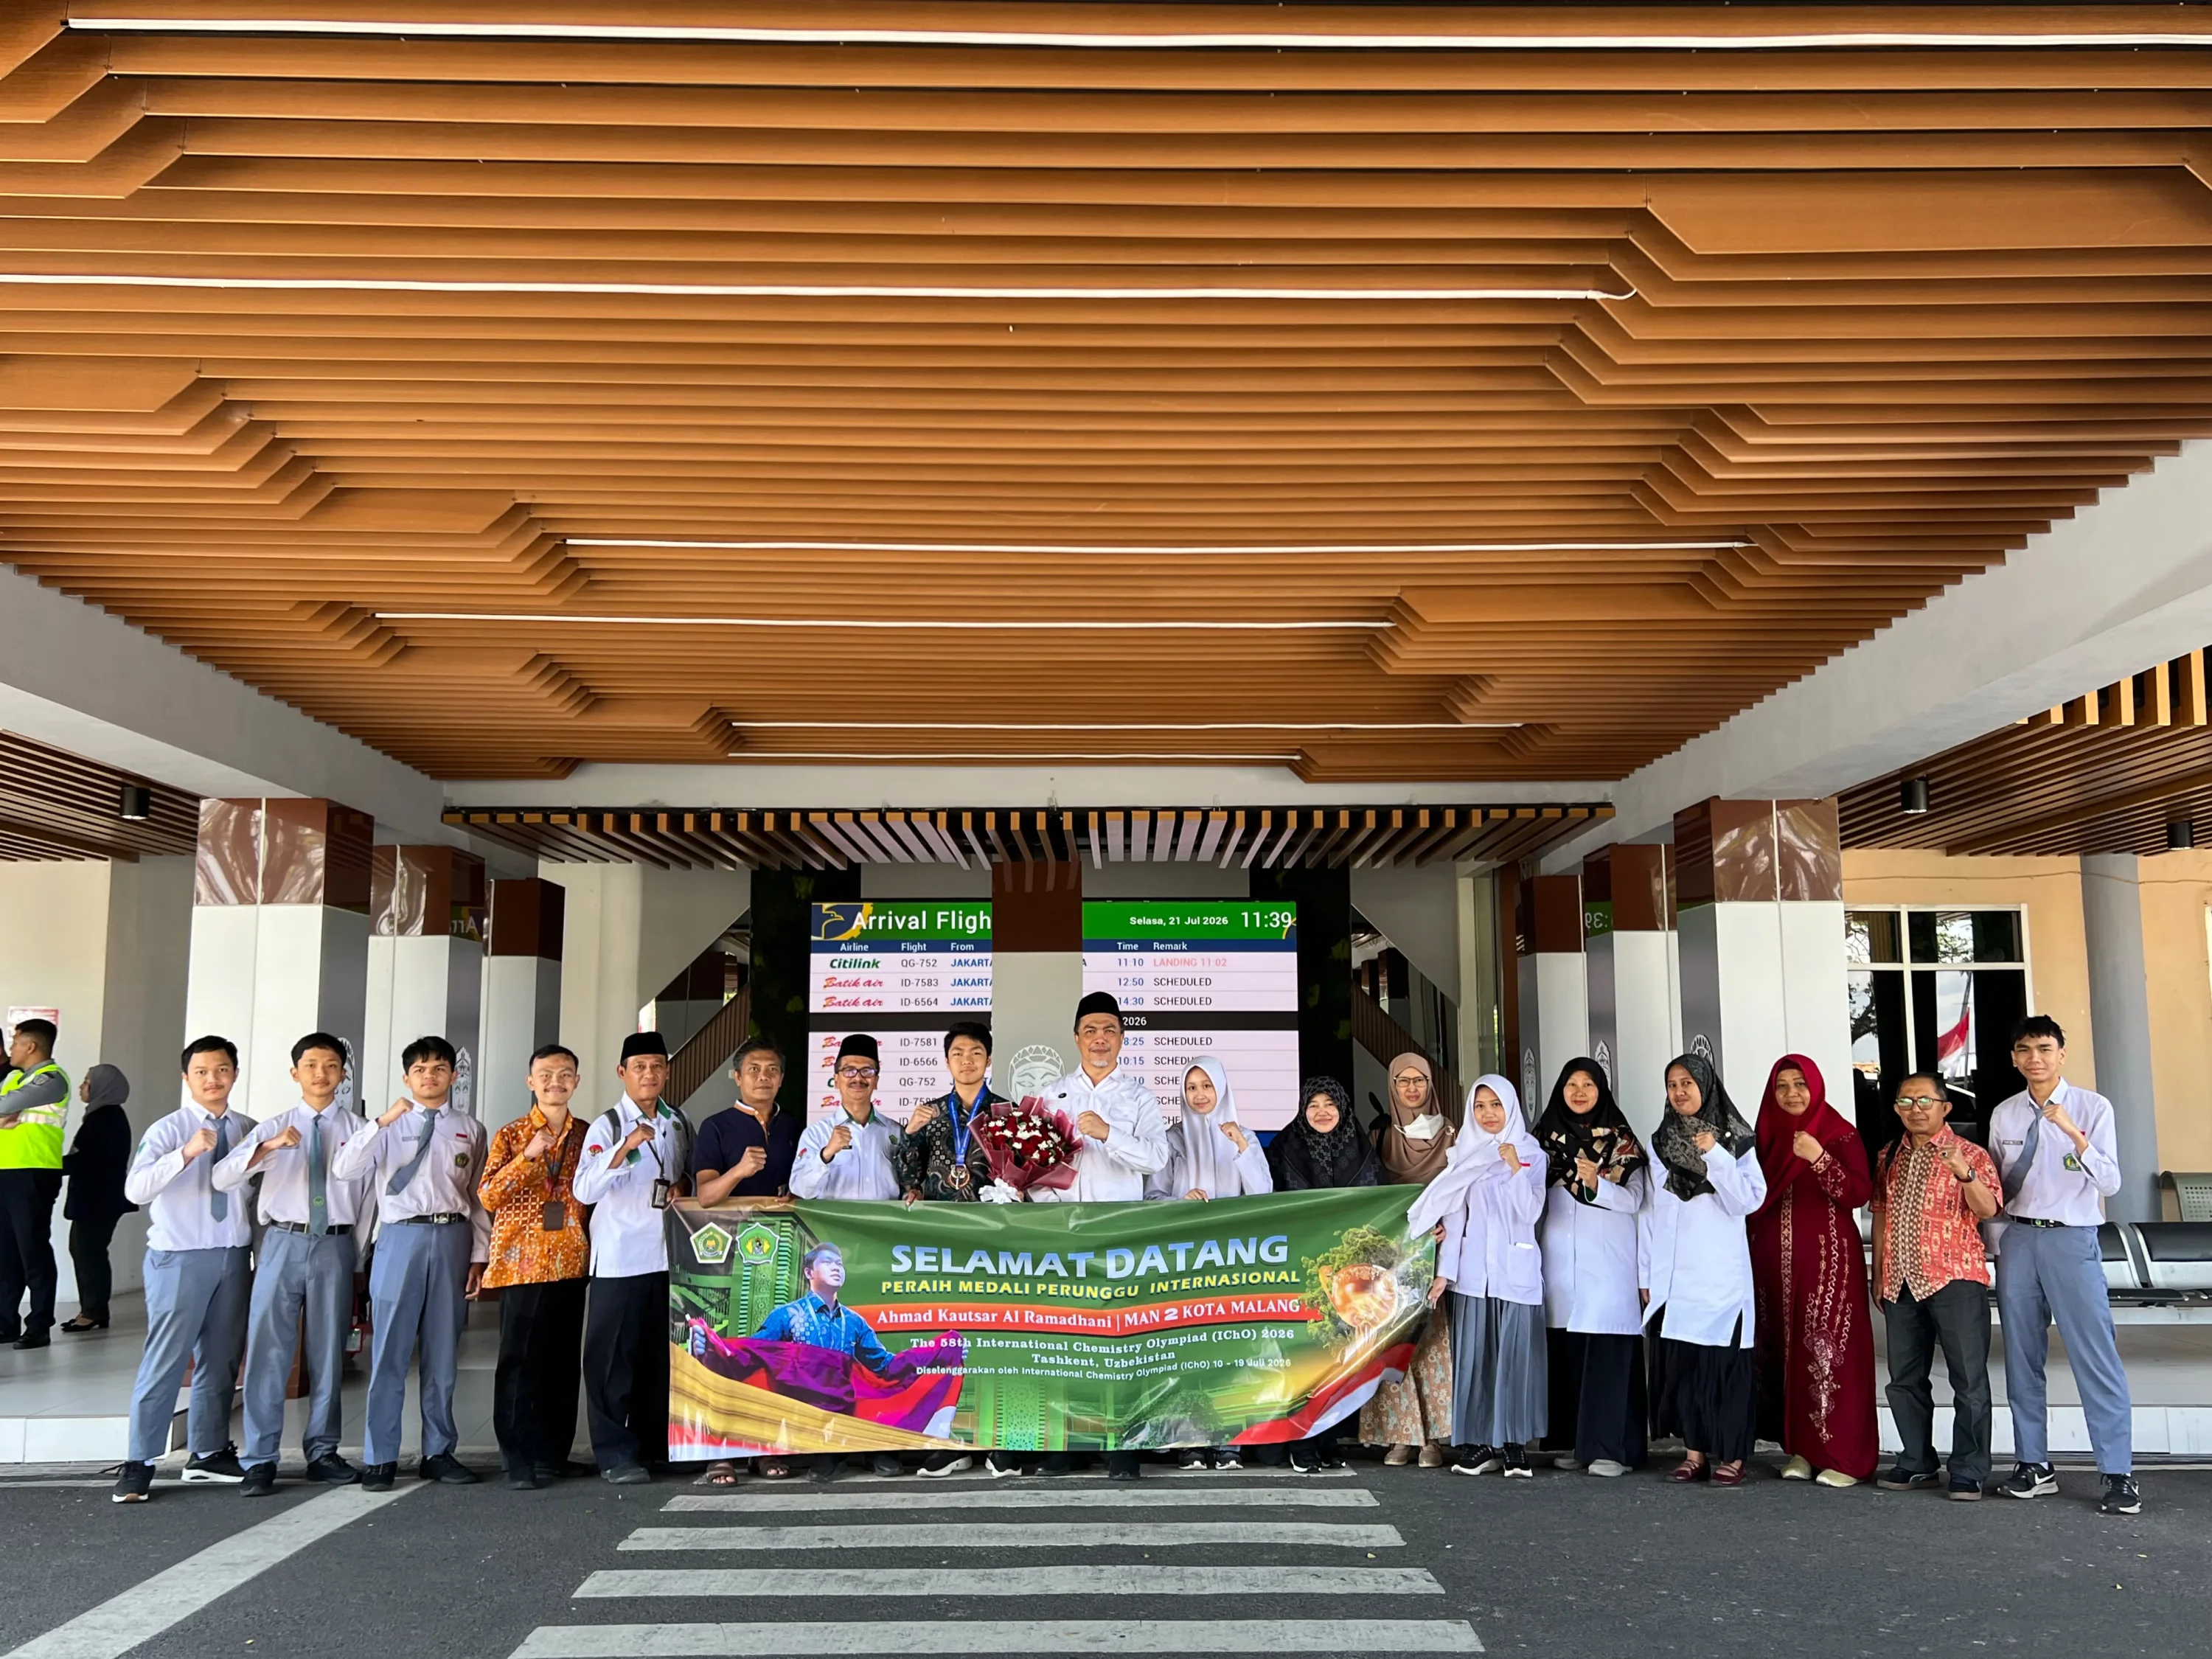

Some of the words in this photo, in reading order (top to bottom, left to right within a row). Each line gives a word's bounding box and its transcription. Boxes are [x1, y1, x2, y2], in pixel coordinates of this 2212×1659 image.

[852, 911, 927, 930] Arrival
[936, 911, 992, 933] Fligh
[1129, 917, 1166, 926] Selasa,
[1169, 917, 1180, 925] 21
[1184, 917, 1200, 925] Jul
[1203, 917, 1229, 925] 2026
[1241, 911, 1292, 928] 11:39
[840, 942, 869, 951] Airline
[901, 942, 927, 953] Flight
[950, 942, 975, 951] From
[1116, 942, 1139, 950] Time
[1152, 941, 1188, 950] Remark
[830, 959, 881, 969] Citilink
[901, 959, 938, 968] QG-752
[1117, 958, 1144, 967] 11:10
[1153, 958, 1198, 967] LANDING
[1200, 958, 1228, 967] 11:02
[823, 976, 861, 990] Batik
[863, 978, 884, 988] air
[901, 978, 939, 987] ID-7583
[1117, 977, 1144, 987] 12:50
[1153, 977, 1212, 987] SCHEDULED
[822, 995, 861, 1009] Batik
[862, 998, 884, 1007] air
[900, 998, 939, 1006] ID-6564
[1117, 997, 1144, 1006] 14:30
[1153, 997, 1213, 1006] SCHEDULED
[1122, 1016, 1147, 1026] 2026
[900, 1037, 937, 1047] ID-7581
[1123, 1037, 1144, 1046] 8:25
[1154, 1037, 1213, 1046] SCHEDULED
[900, 1057, 938, 1066] ID-6566
[1118, 1056, 1144, 1065] 10:15
[899, 1077, 936, 1087] QG-752
[891, 1245, 1095, 1278] SELAMAT
[1106, 1235, 1288, 1280] DATANG
[881, 1279, 953, 1294] PERAIH
[959, 1281, 1030, 1295] MEDALI
[1036, 1283, 1139, 1301] PERUNGGU
[1150, 1270, 1301, 1294] INTERNASIONAL
[877, 1309, 933, 1324] Ahmad
[937, 1308, 998, 1323] Kautsar
[1002, 1310, 1019, 1324] Al
[1023, 1310, 1112, 1328] Ramadhani
[1124, 1308, 1161, 1328] MAN
[1164, 1307, 1178, 1321] 2
[1182, 1302, 1226, 1319] KOTA
[1231, 1298, 1300, 1315] MALANG
[910, 1338, 936, 1348] The
[940, 1337, 972, 1348] 58th
[976, 1338, 1068, 1351] International
[1073, 1341, 1143, 1354] Chemistry
[1146, 1332, 1208, 1349] Olympiad
[1211, 1329, 1257, 1343] (IChO)
[1262, 1329, 1294, 1339] 2026
[1032, 1354, 1099, 1368] Tashkent,
[1104, 1351, 1175, 1368] Uzbekistan
[916, 1366, 995, 1377] Diselenggarakan
[998, 1366, 1019, 1374] oleh
[1022, 1366, 1083, 1378] International
[1086, 1371, 1134, 1381] Chemistry
[1136, 1362, 1178, 1377] Olympiad
[1180, 1360, 1211, 1371] (IChO)
[1213, 1360, 1224, 1368] 10
[1234, 1359, 1245, 1367] 19
[1247, 1358, 1265, 1367] Juli
[1267, 1358, 1292, 1368] 2026
